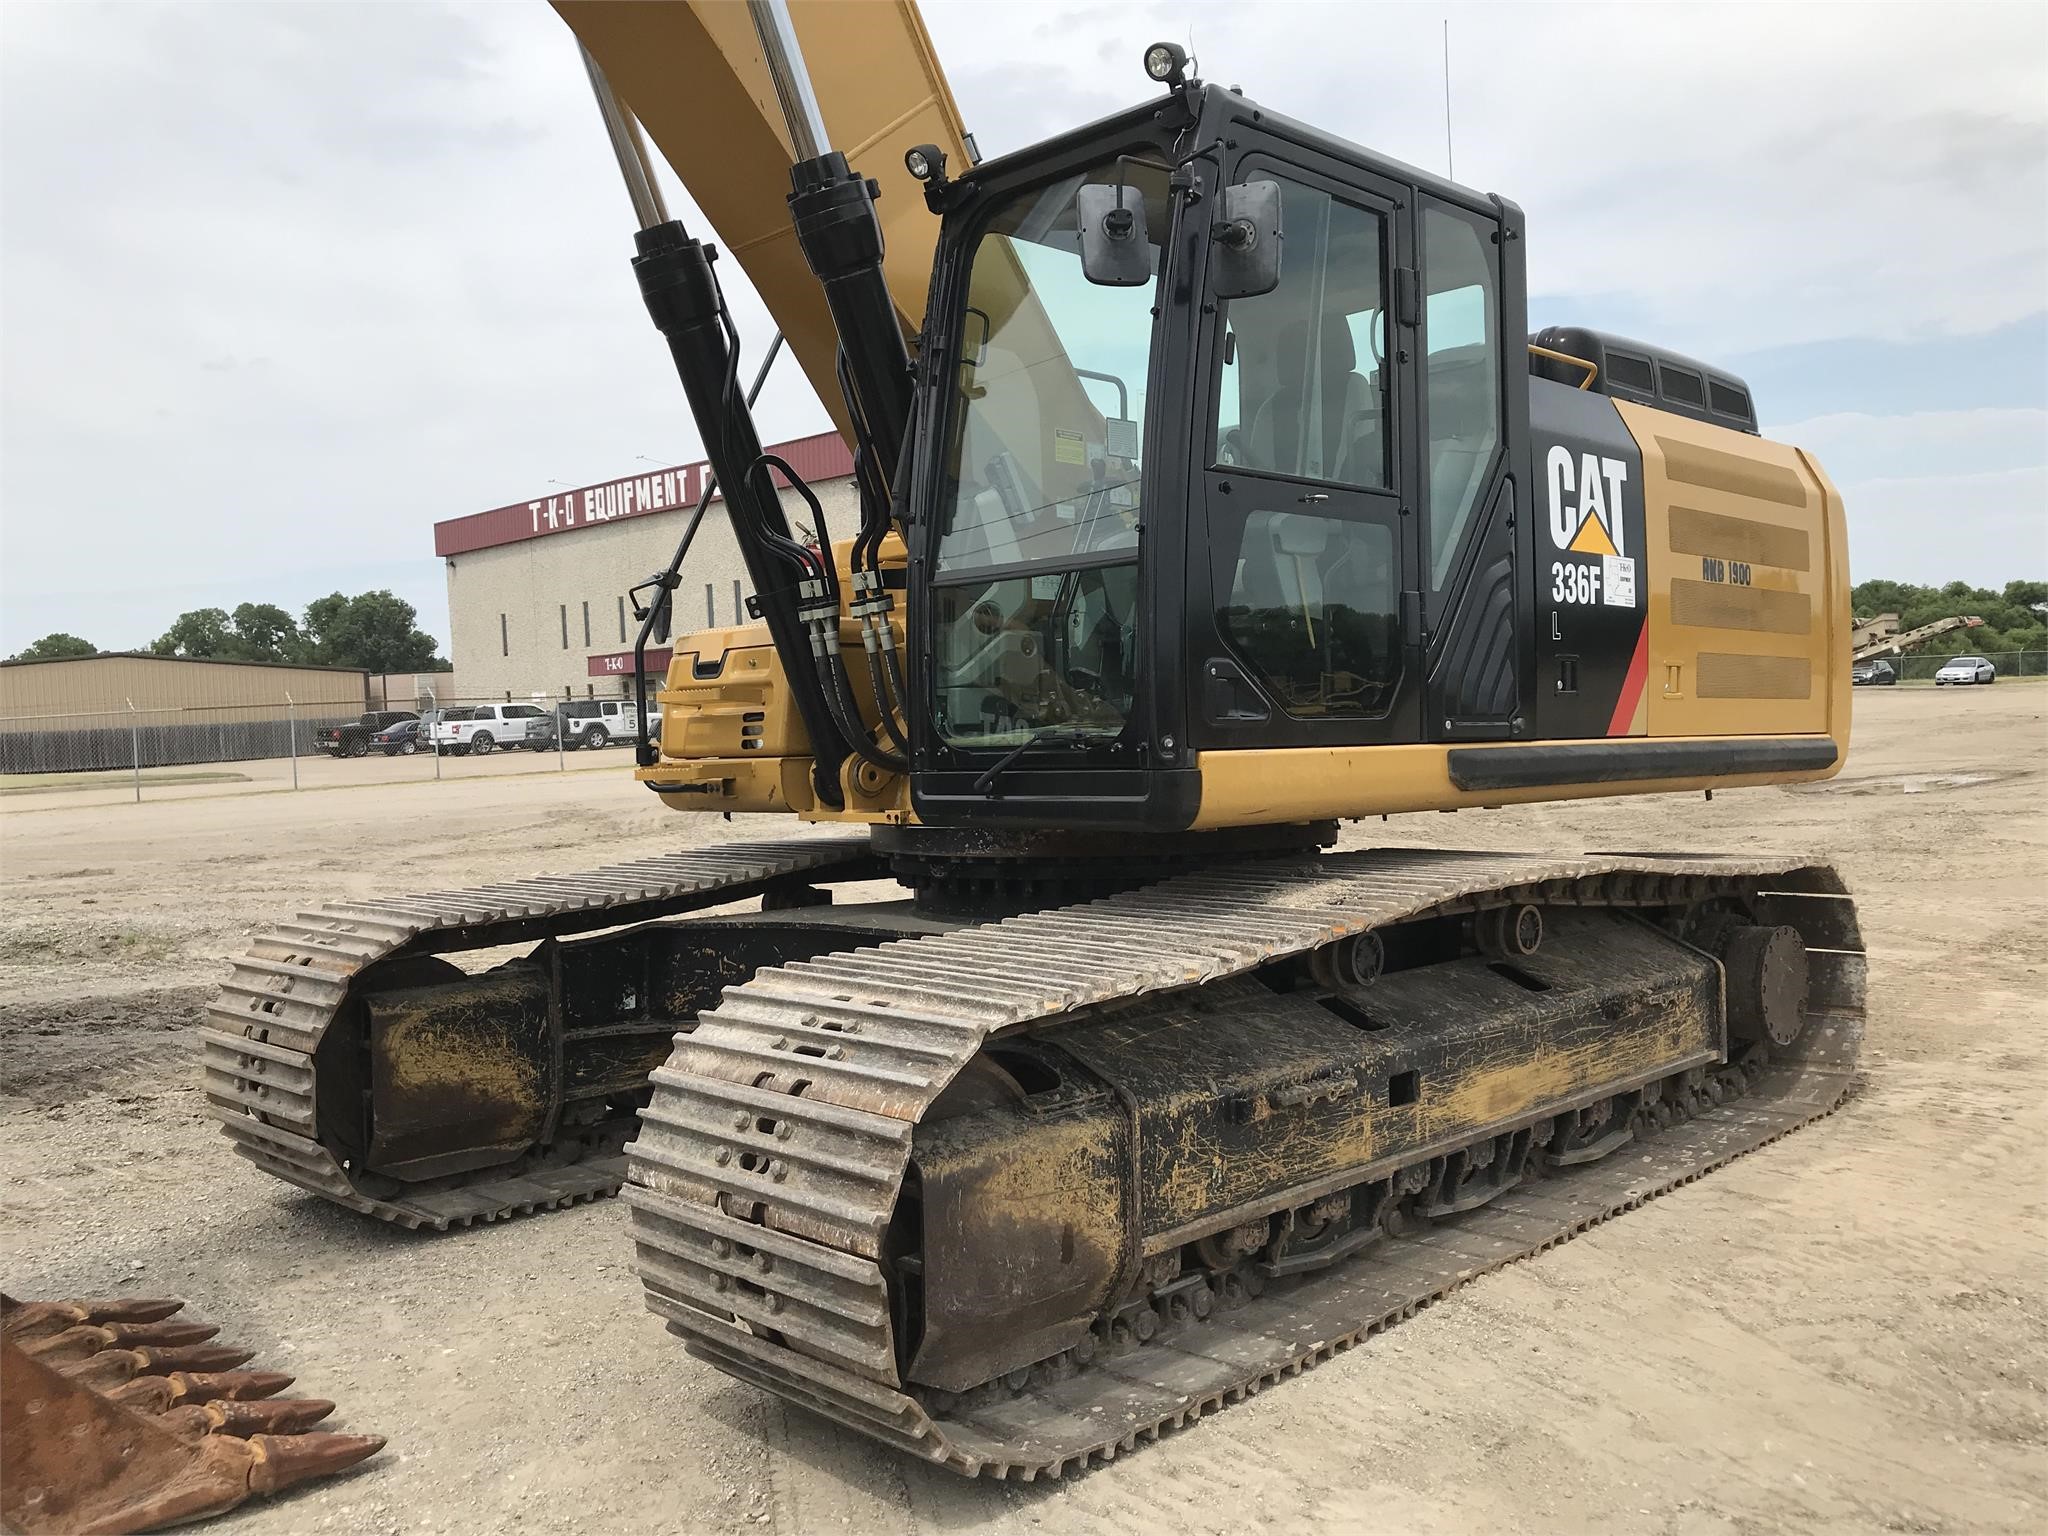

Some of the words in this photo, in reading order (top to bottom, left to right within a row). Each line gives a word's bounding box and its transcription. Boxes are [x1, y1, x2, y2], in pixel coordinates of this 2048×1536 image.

[529, 494, 575, 532] T-K-O
[584, 470, 687, 520] EQUIPMENT
[1547, 445, 1627, 557] CAT
[1552, 562, 1600, 605] 336F
[1728, 561, 1751, 586] 1900
[1552, 611, 1561, 640] L
[605, 657, 624, 670] T-K-O
[629, 720, 636, 729] 5
